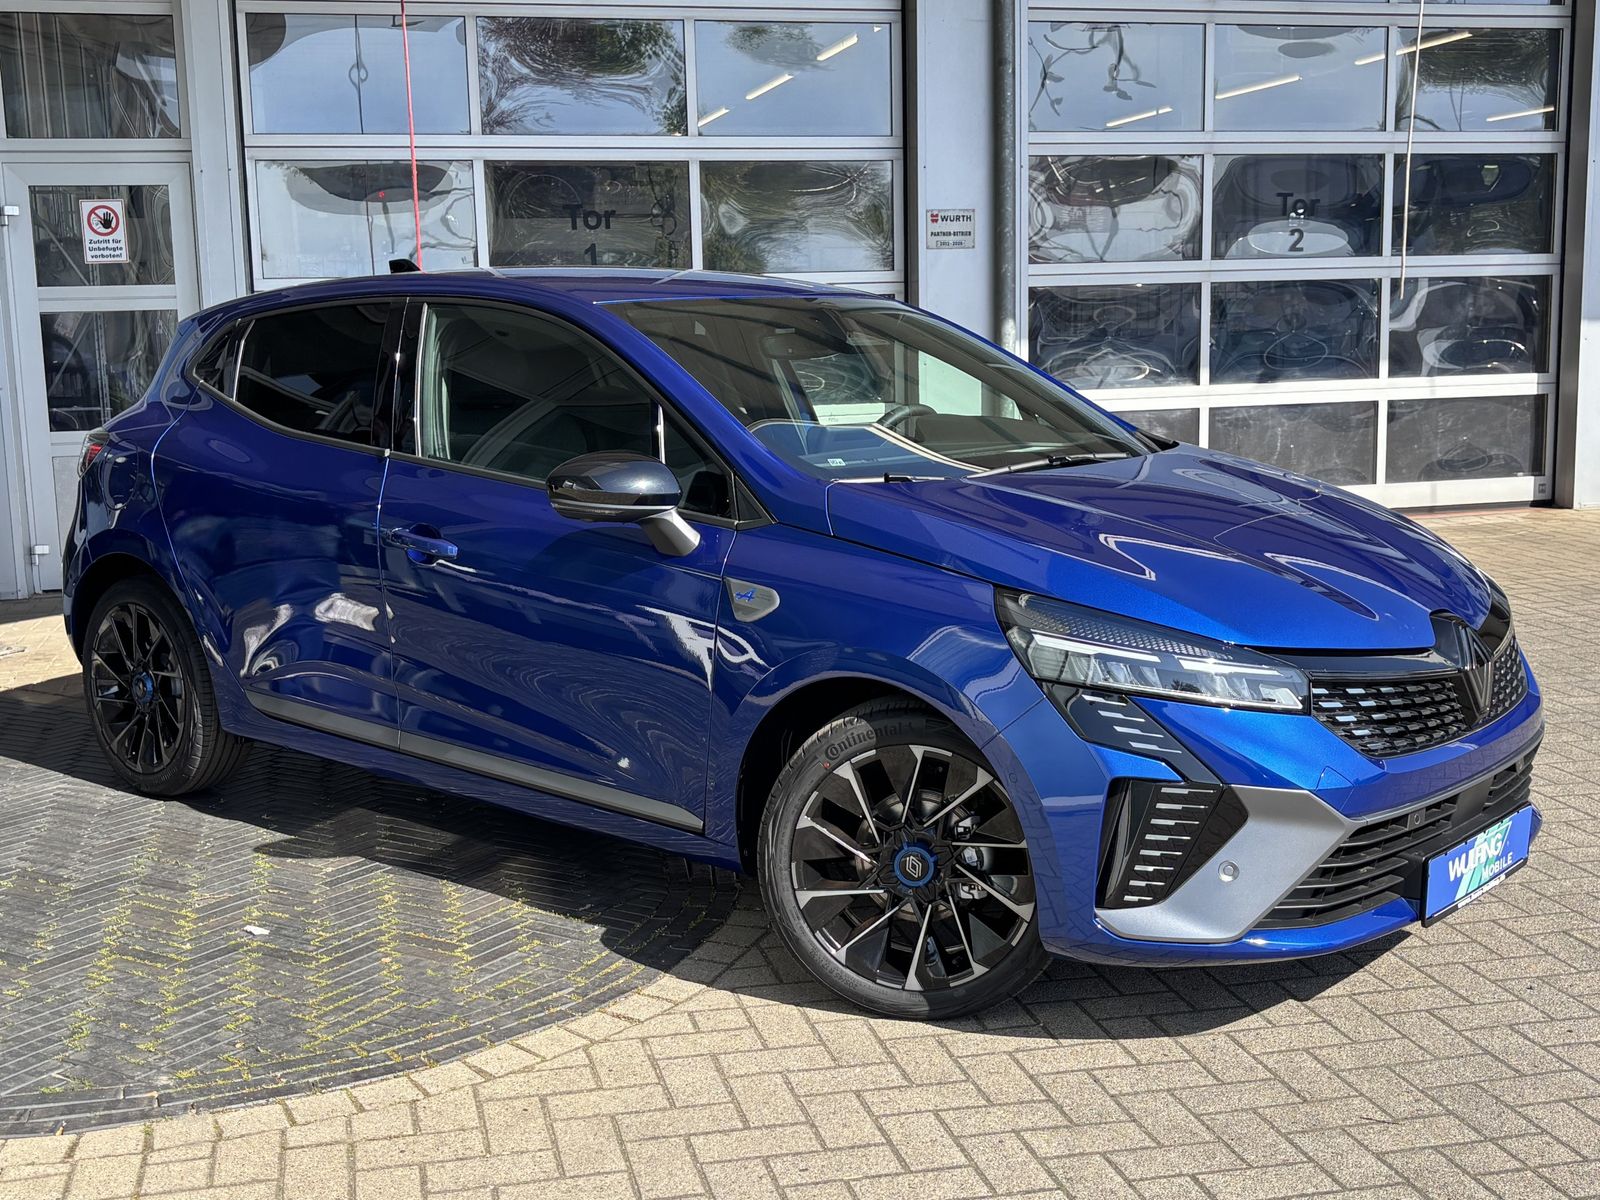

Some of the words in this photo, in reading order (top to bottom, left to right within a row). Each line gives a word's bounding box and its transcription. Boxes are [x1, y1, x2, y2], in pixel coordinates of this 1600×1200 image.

[562, 204, 616, 230] Tor
[1276, 192, 1320, 217] Tor
[1288, 228, 1304, 252] 2
[583, 243, 598, 266] 1
[824, 721, 902, 760] Continental
[1482, 851, 1513, 880] MOBILE
